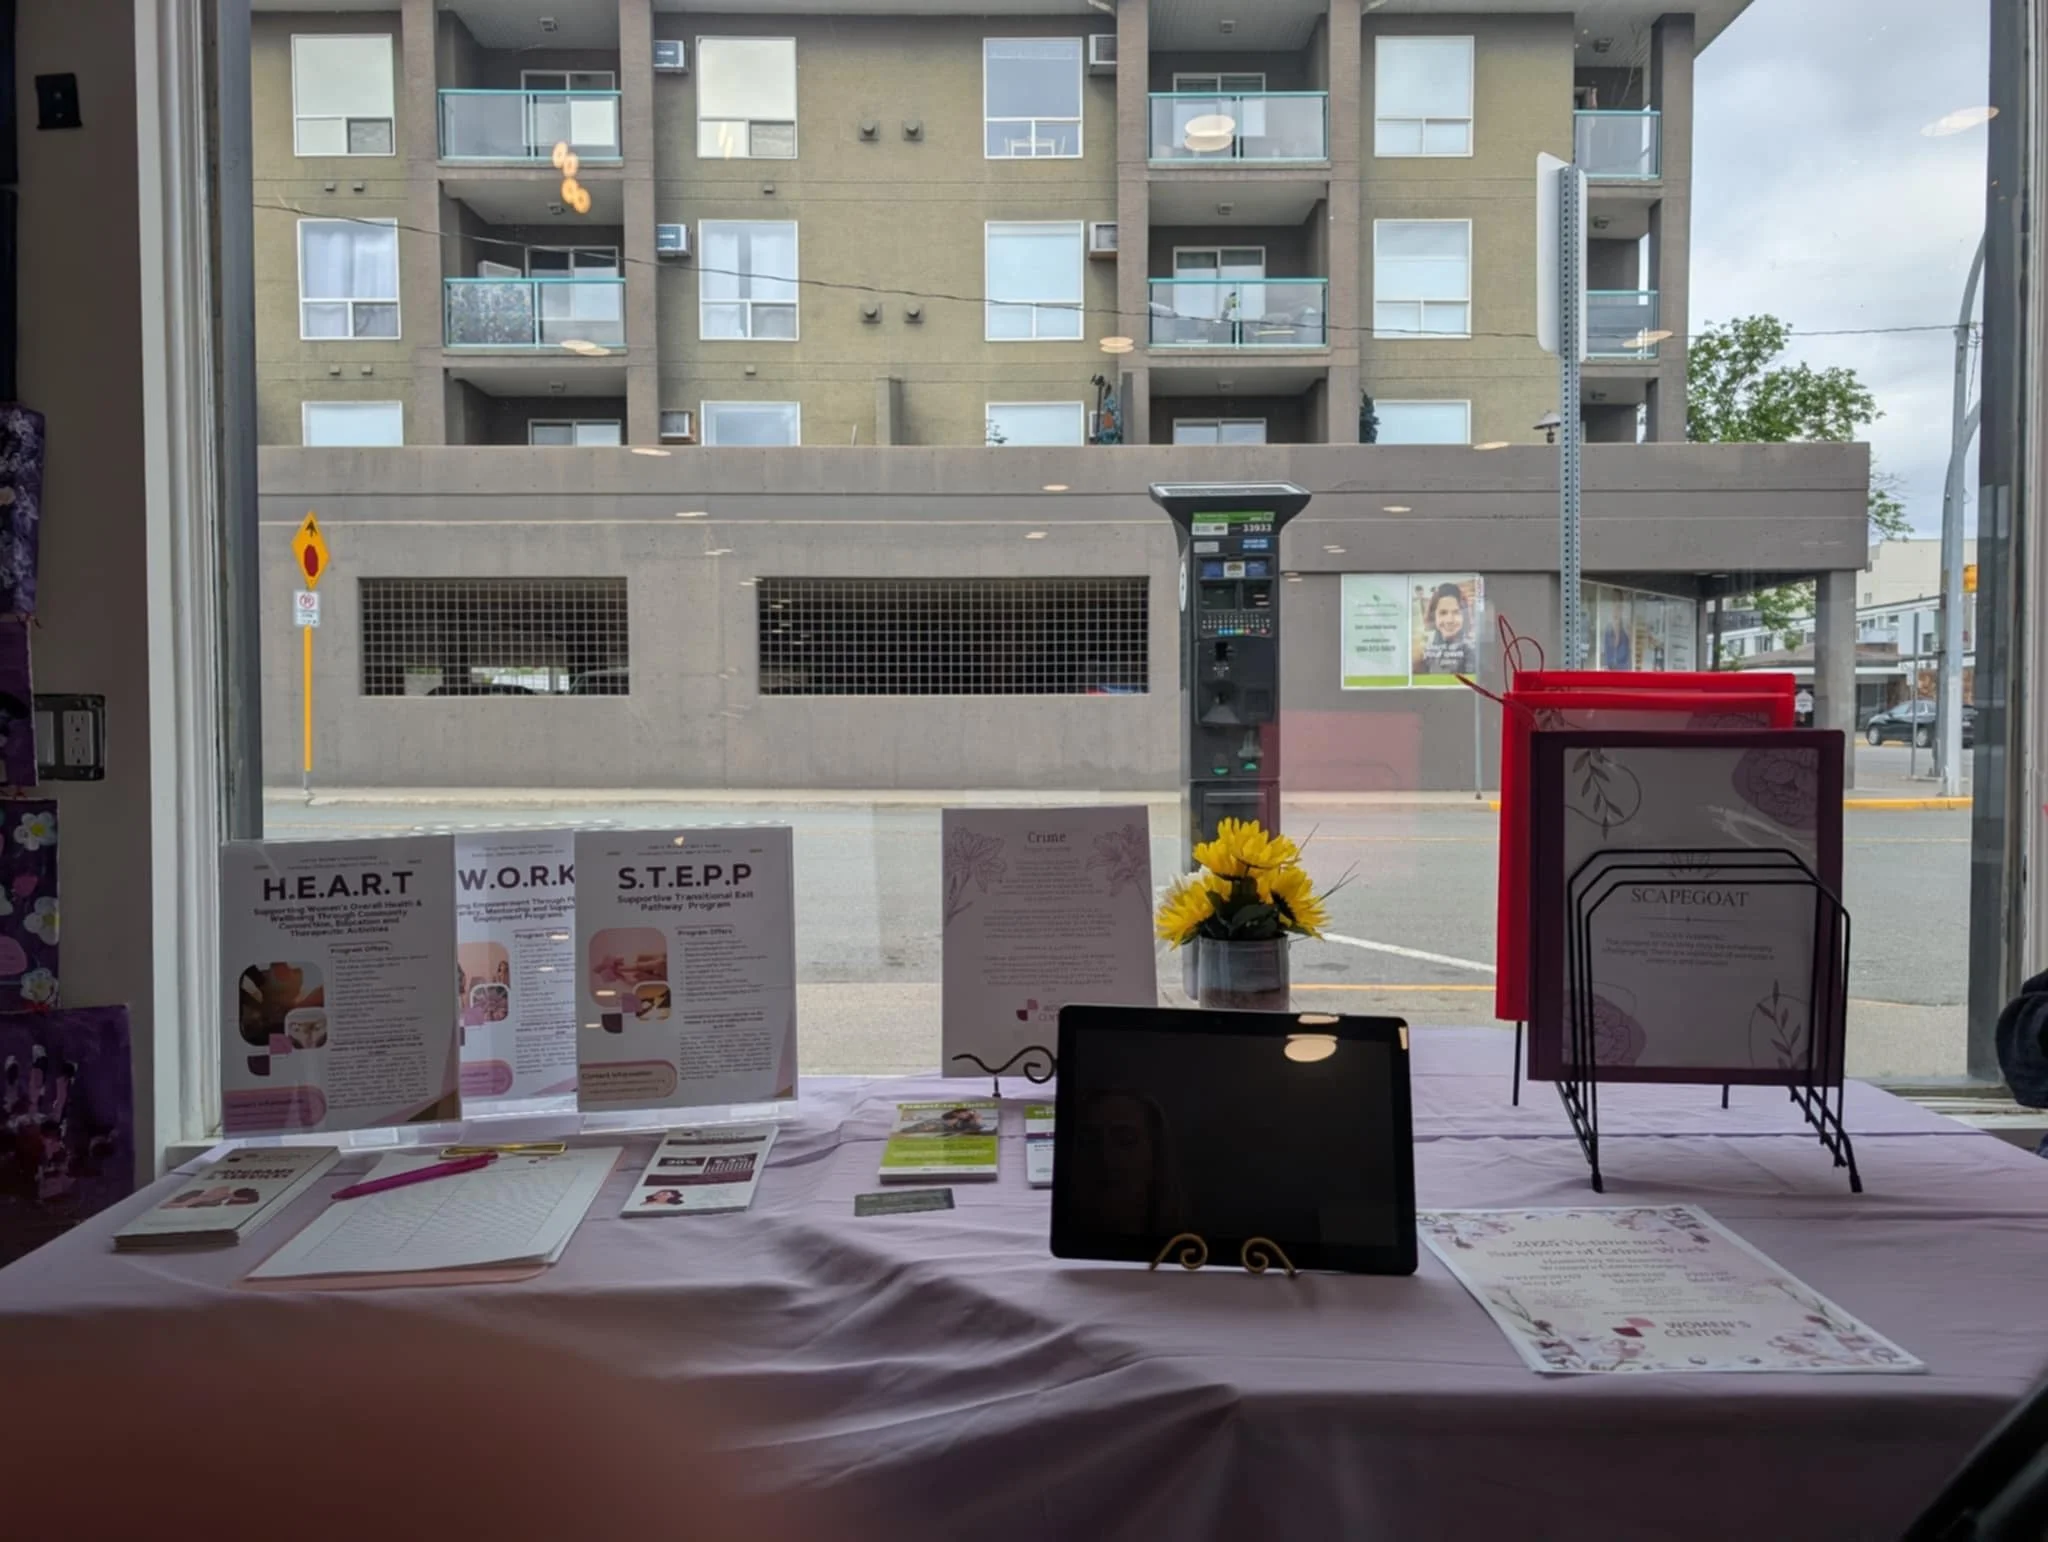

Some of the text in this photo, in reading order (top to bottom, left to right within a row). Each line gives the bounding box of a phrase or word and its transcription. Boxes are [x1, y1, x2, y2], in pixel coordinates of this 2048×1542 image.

[1028, 831, 1067, 843] Crime
[618, 863, 752, 889] S.T.E.P.P
[264, 871, 413, 901] H.E.A.R.T
[617, 891, 753, 904] Supportive Transitional Exit
[1631, 887, 1749, 908] SCAPEGOAT
[351, 900, 383, 909] Overall
[641, 901, 731, 912] Pathway Program
[1664, 1319, 1752, 1329] WOMEN'S
[1663, 1329, 1736, 1338] CENTRE
